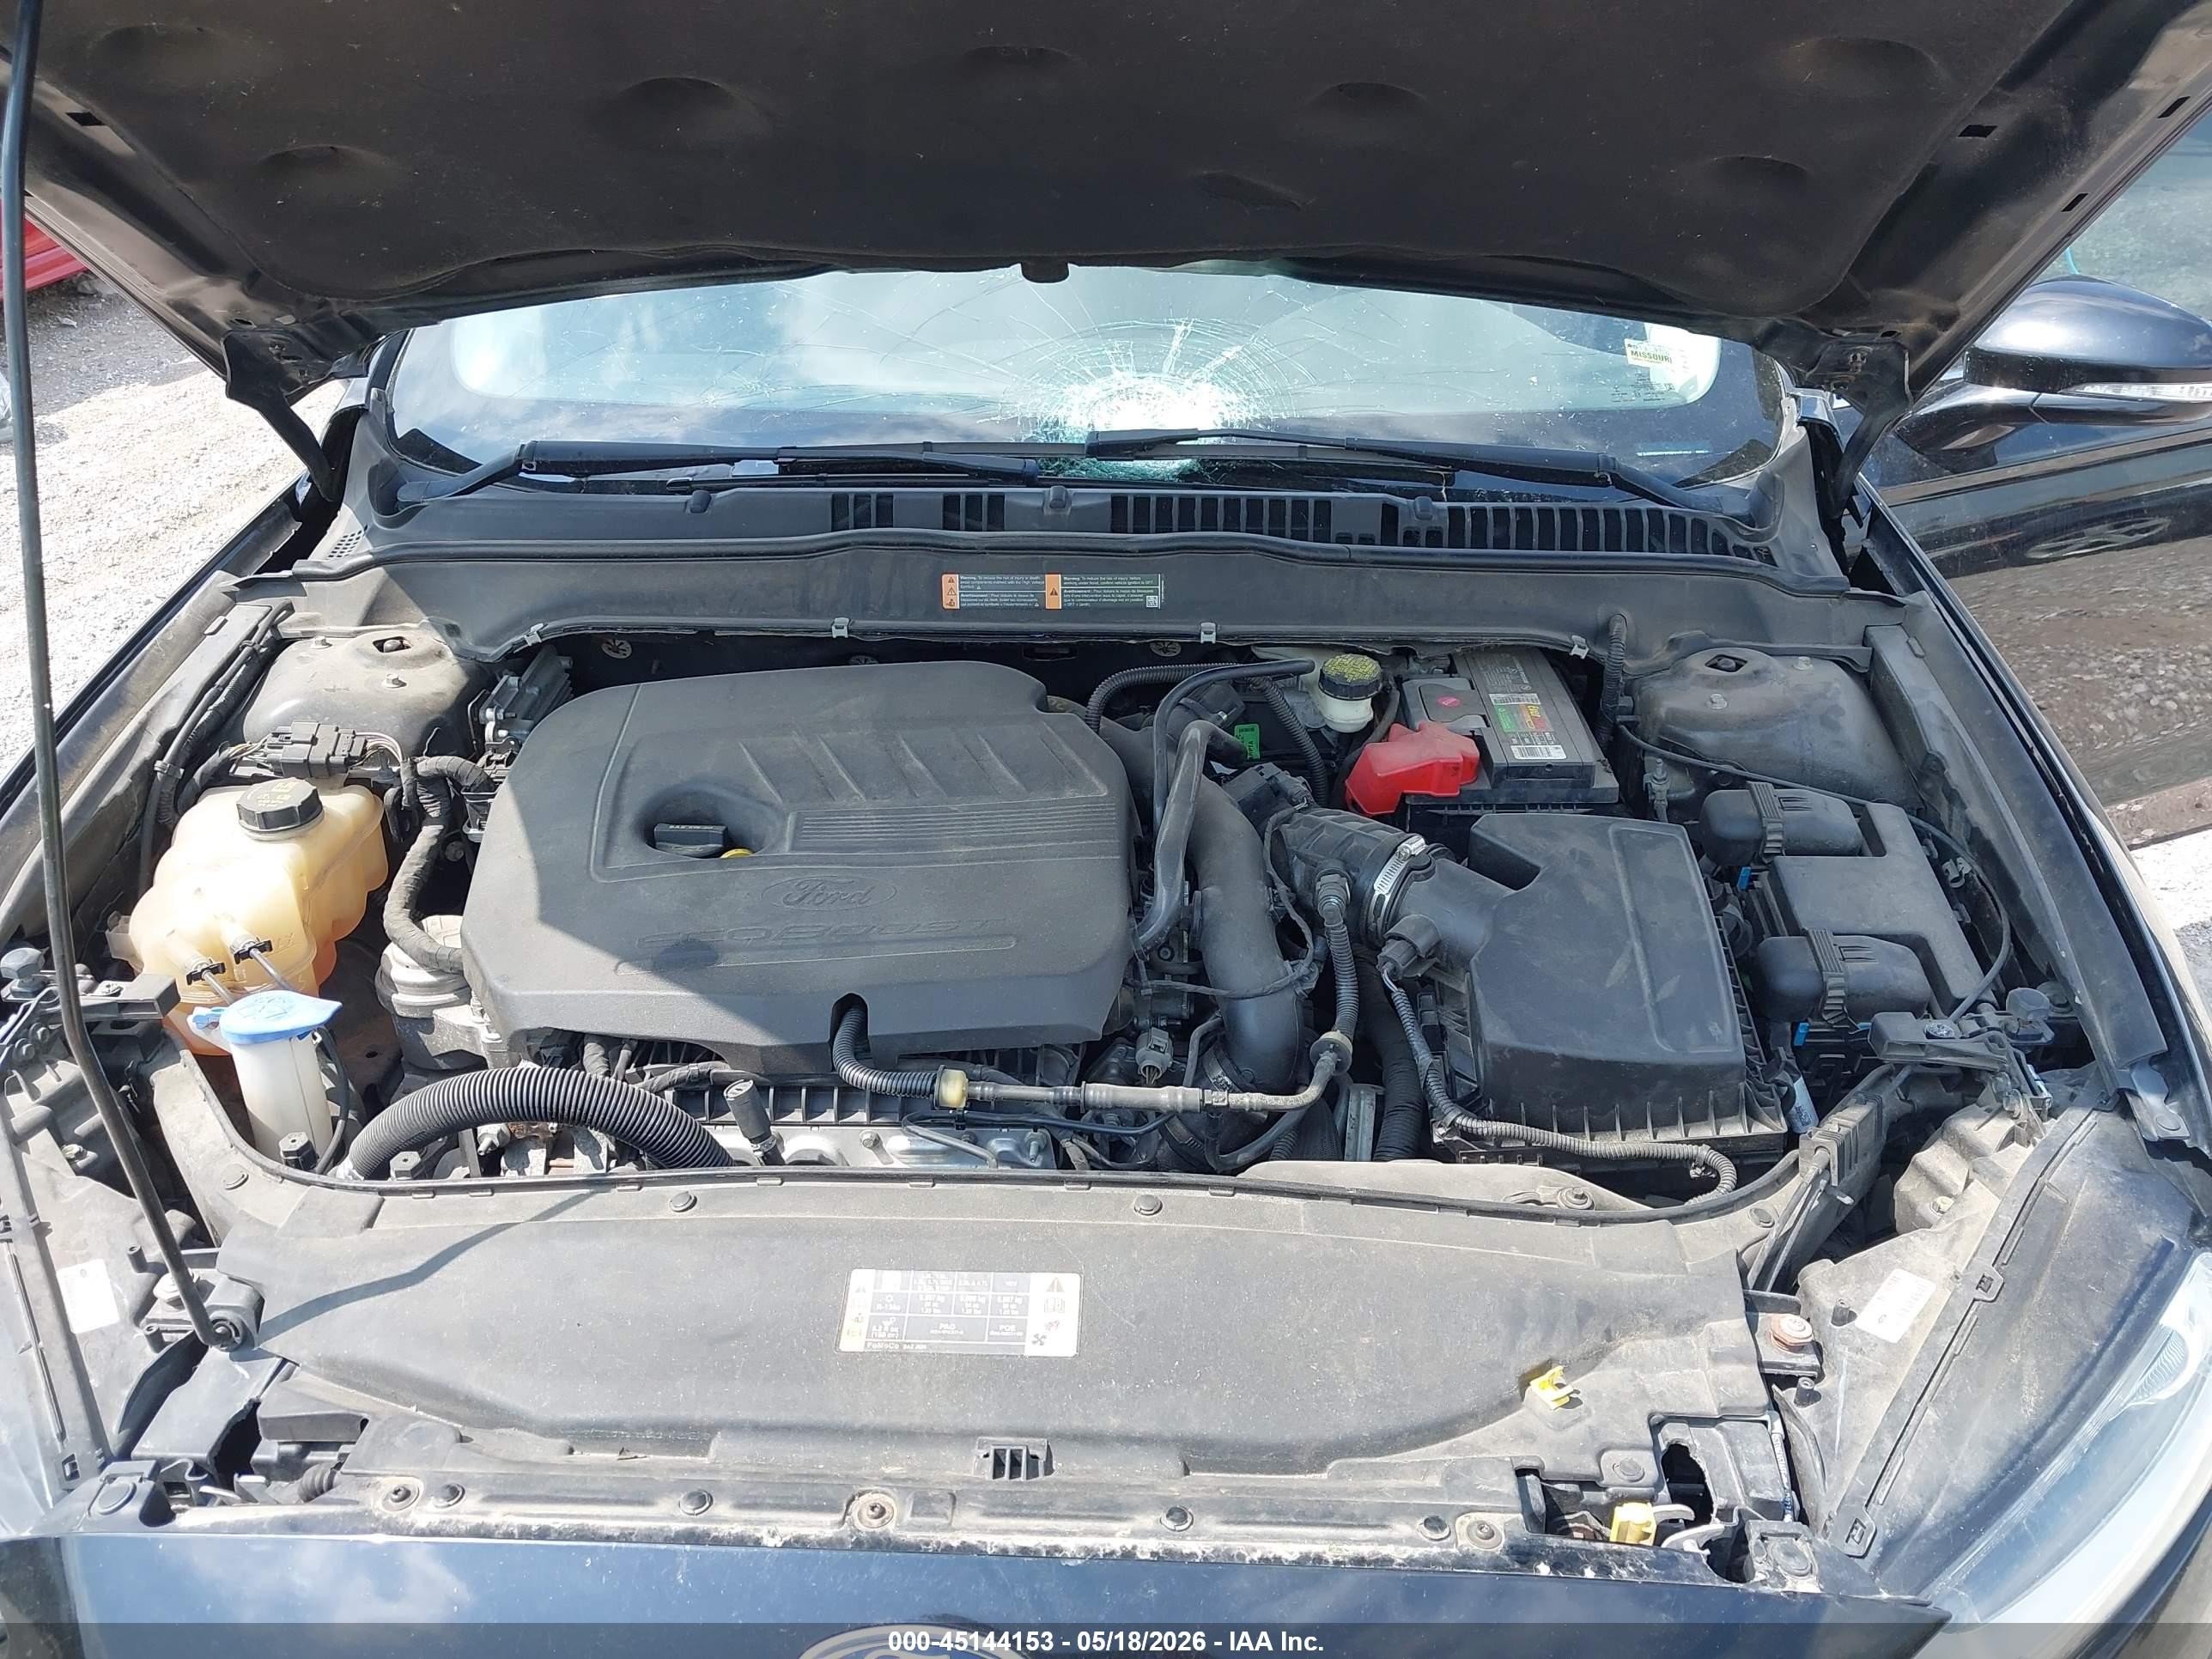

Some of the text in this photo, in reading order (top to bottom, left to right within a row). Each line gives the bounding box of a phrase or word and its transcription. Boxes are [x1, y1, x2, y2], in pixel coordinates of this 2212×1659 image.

[1631, 349, 1673, 364] MISSOURI
[782, 878, 872, 907] Ford
[867, 1341, 900, 1350] FoMoCo
